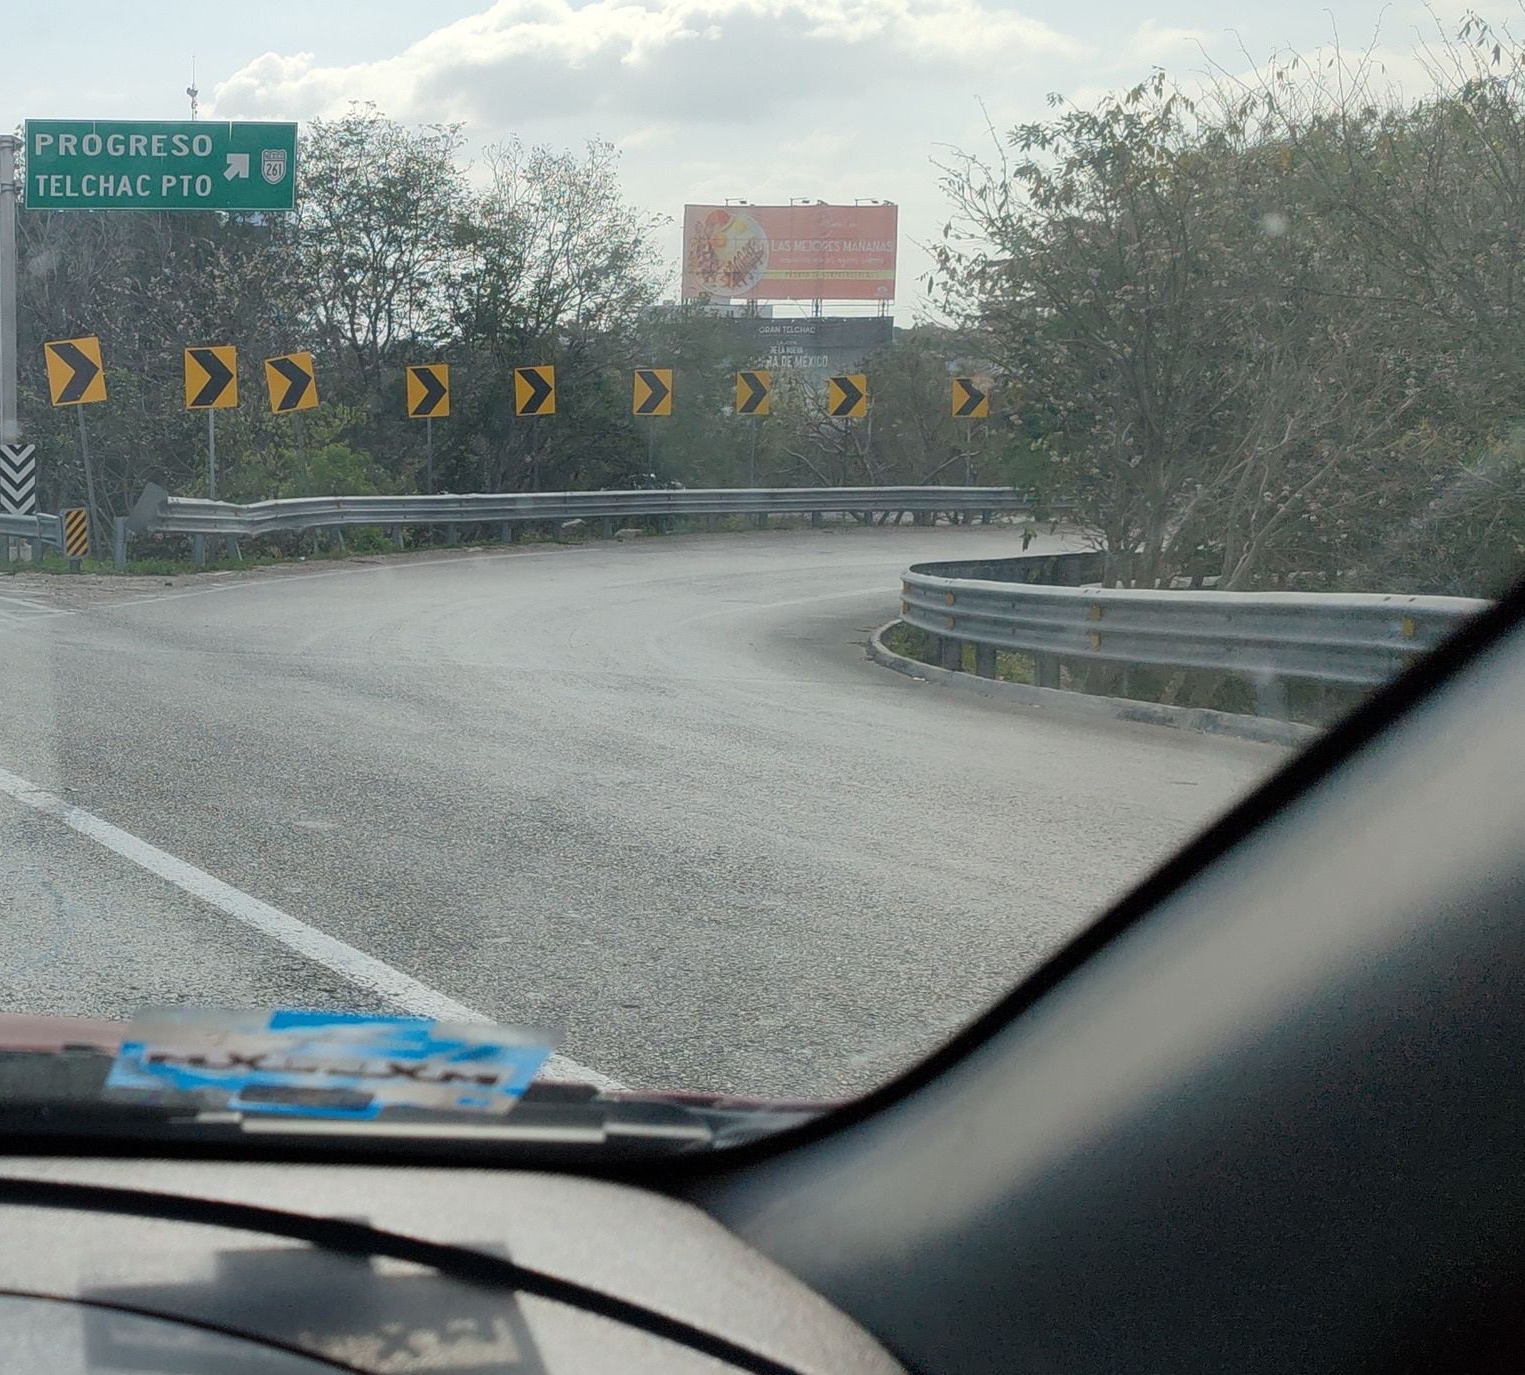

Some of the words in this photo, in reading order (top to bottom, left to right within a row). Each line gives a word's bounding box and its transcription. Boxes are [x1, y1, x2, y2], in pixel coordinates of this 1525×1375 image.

[35, 133, 213, 157] PROGRESO
[266, 163, 282, 177] 261
[35, 174, 151, 197] TELCHAC
[161, 174, 212, 197] PTO
[771, 240, 790, 252] LAS
[794, 240, 840, 252] MEJORES
[843, 238, 892, 252] MAÑANAS
[759, 325, 780, 334] GRAN
[782, 325, 816, 334] TELCHAC
[781, 355, 792, 368] DE
[795, 353, 828, 368] MÉXICO
